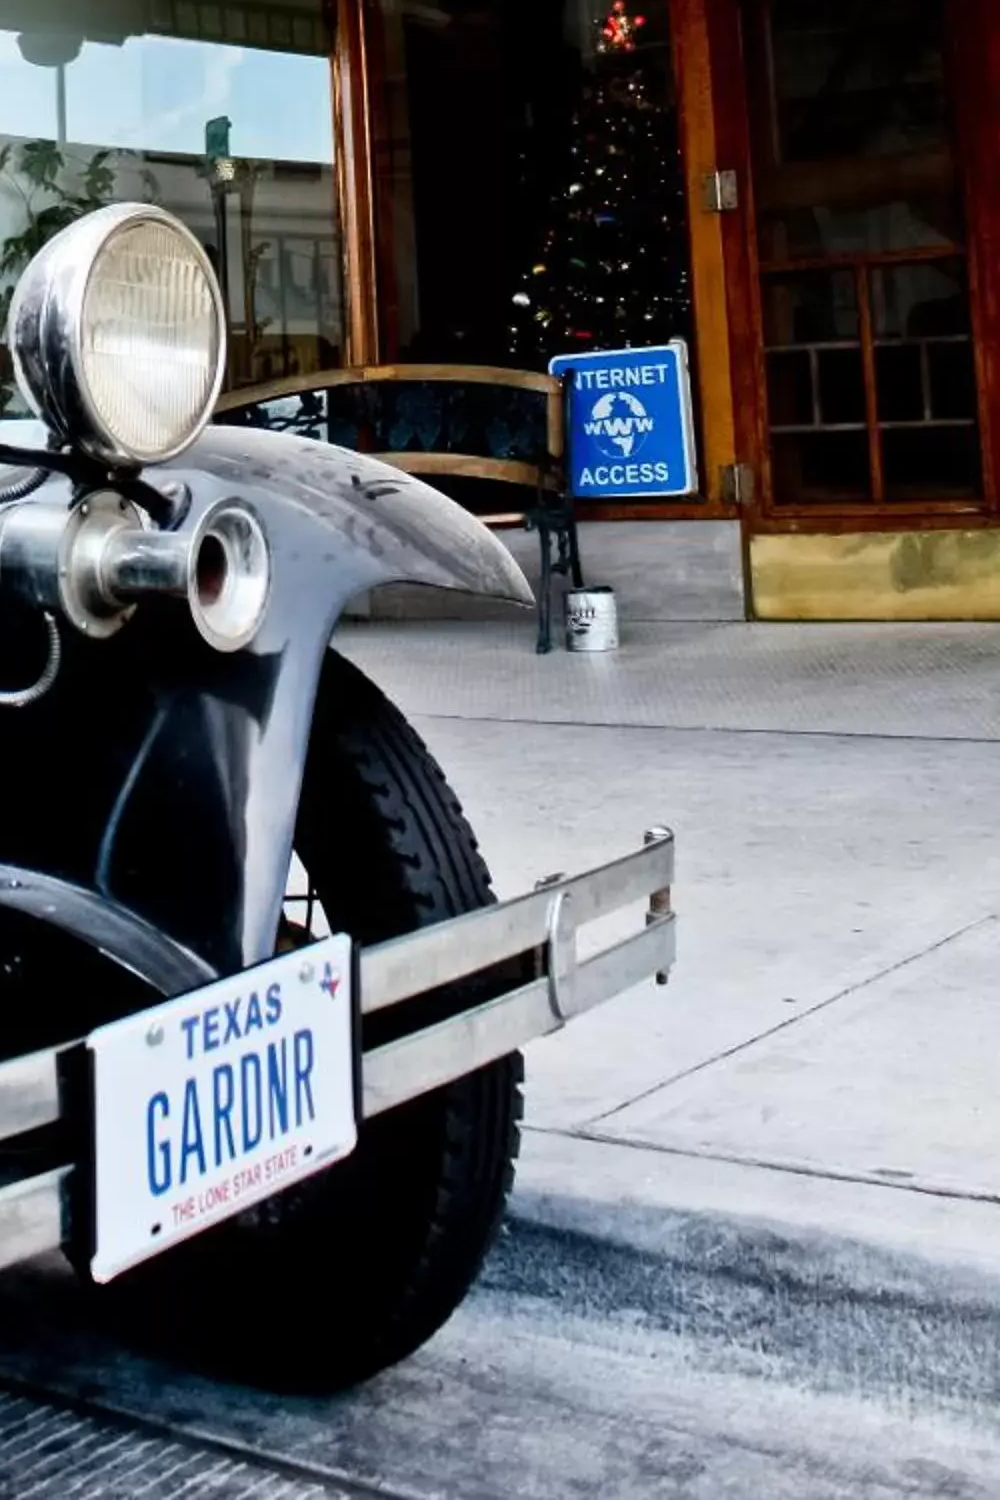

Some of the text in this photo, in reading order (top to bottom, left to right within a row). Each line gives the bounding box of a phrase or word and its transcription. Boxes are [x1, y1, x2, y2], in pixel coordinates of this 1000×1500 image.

[579, 462, 669, 487] ACCESS
[181, 983, 282, 1060] TEXAS
[147, 1028, 316, 1197] GARDNR
[171, 1197, 197, 1226] THE
[199, 1178, 231, 1214] LONE
[232, 1162, 264, 1198] STAR
[264, 1145, 298, 1181] STATE
